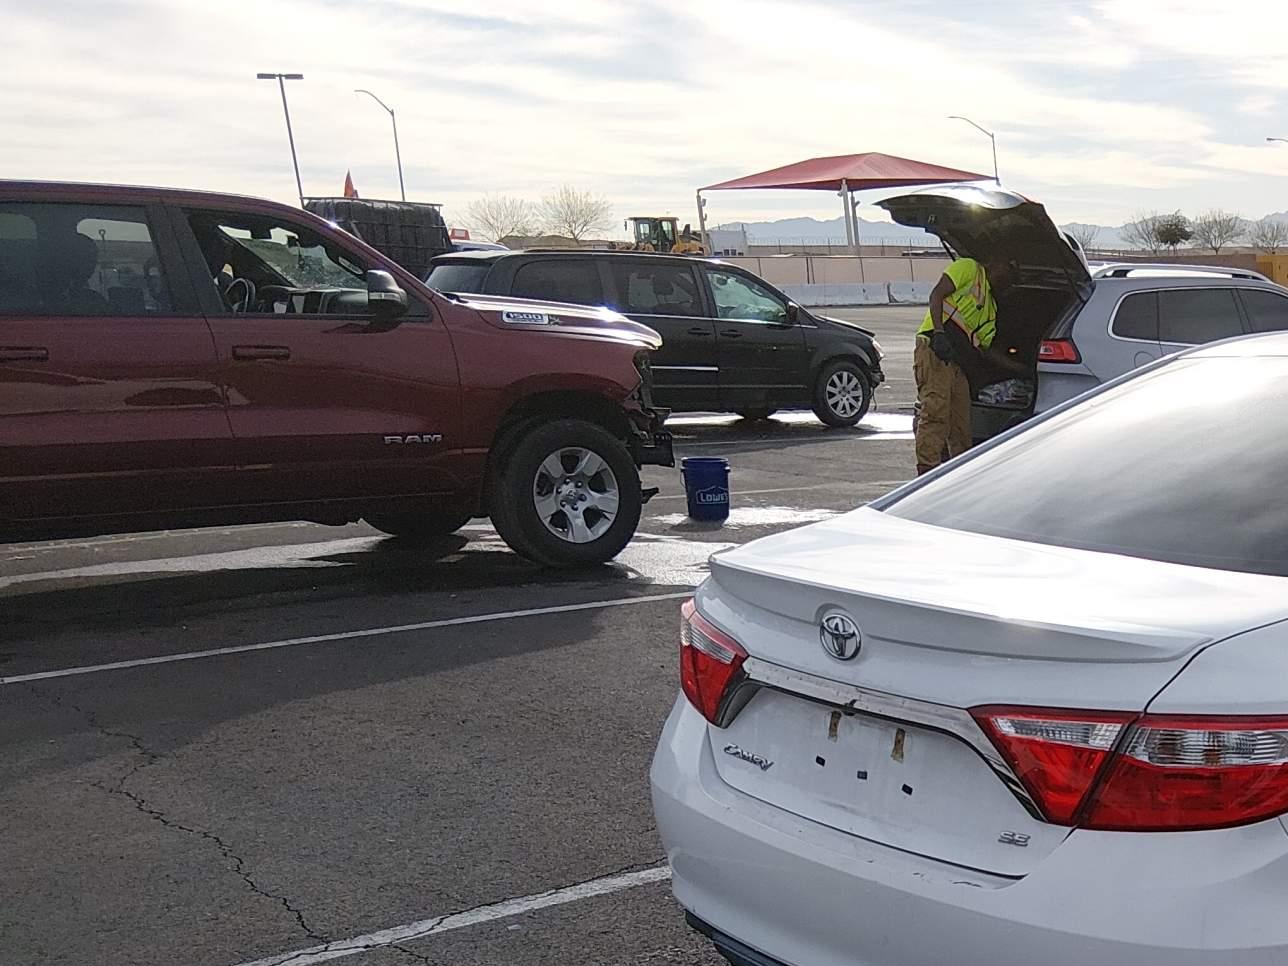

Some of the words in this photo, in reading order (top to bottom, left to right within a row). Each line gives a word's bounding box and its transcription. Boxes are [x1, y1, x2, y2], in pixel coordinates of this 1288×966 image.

[508, 312, 543, 320] 1500
[384, 434, 442, 444] RAM
[998, 831, 1031, 847] SE
